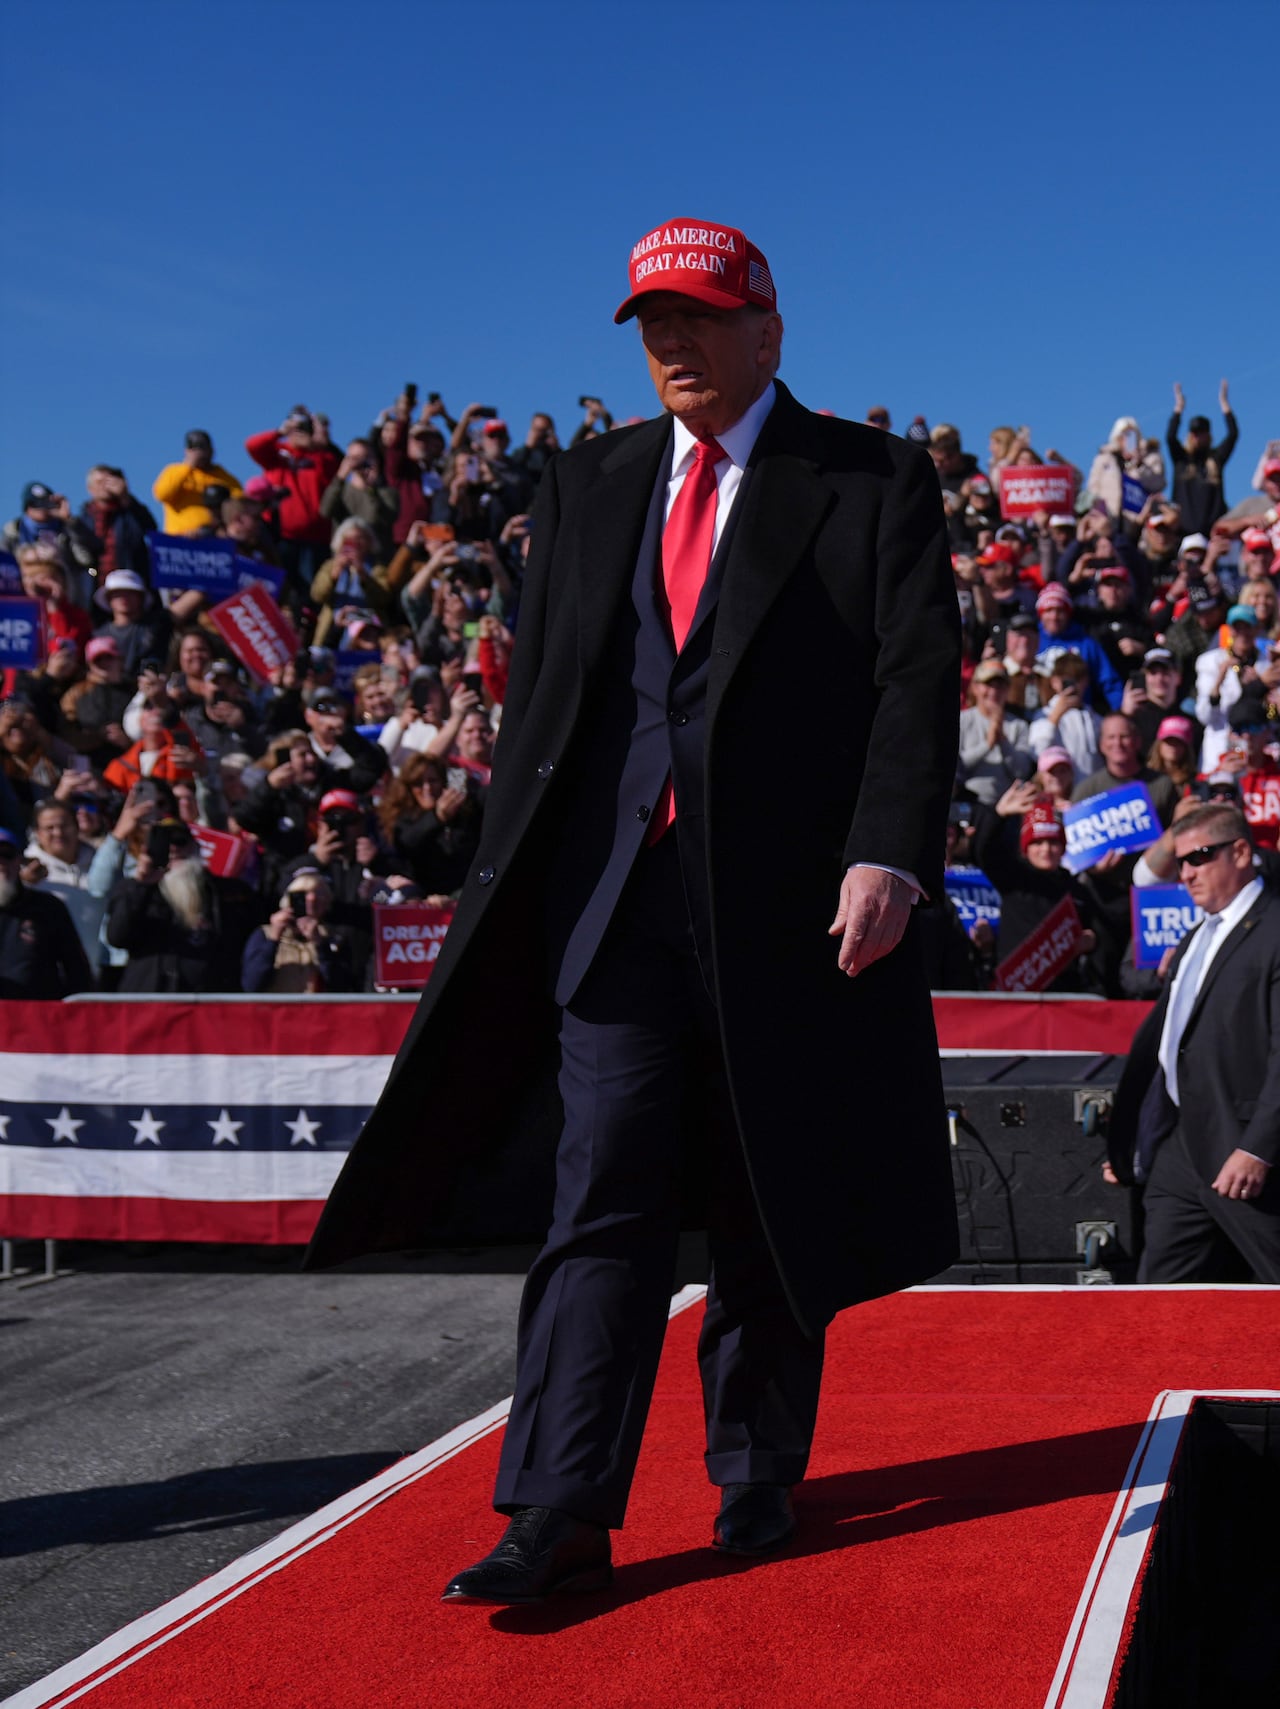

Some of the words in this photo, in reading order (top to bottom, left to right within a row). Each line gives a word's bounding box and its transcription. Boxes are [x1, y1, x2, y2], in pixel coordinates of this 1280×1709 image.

[632, 231, 661, 262] MAKE
[662, 227, 737, 253] AMERICA
[636, 252, 673, 283] GREAT
[674, 252, 726, 276] AGAIN
[155, 547, 232, 567] TRUMP
[1065, 799, 1147, 845] TRUMP
[1066, 832, 1109, 855] WILL
[1107, 821, 1136, 841] FIX
[1134, 814, 1153, 832] IT
[1141, 904, 1204, 931] TRU
[382, 924, 449, 941] DREAM
[386, 941, 442, 963] AGA
